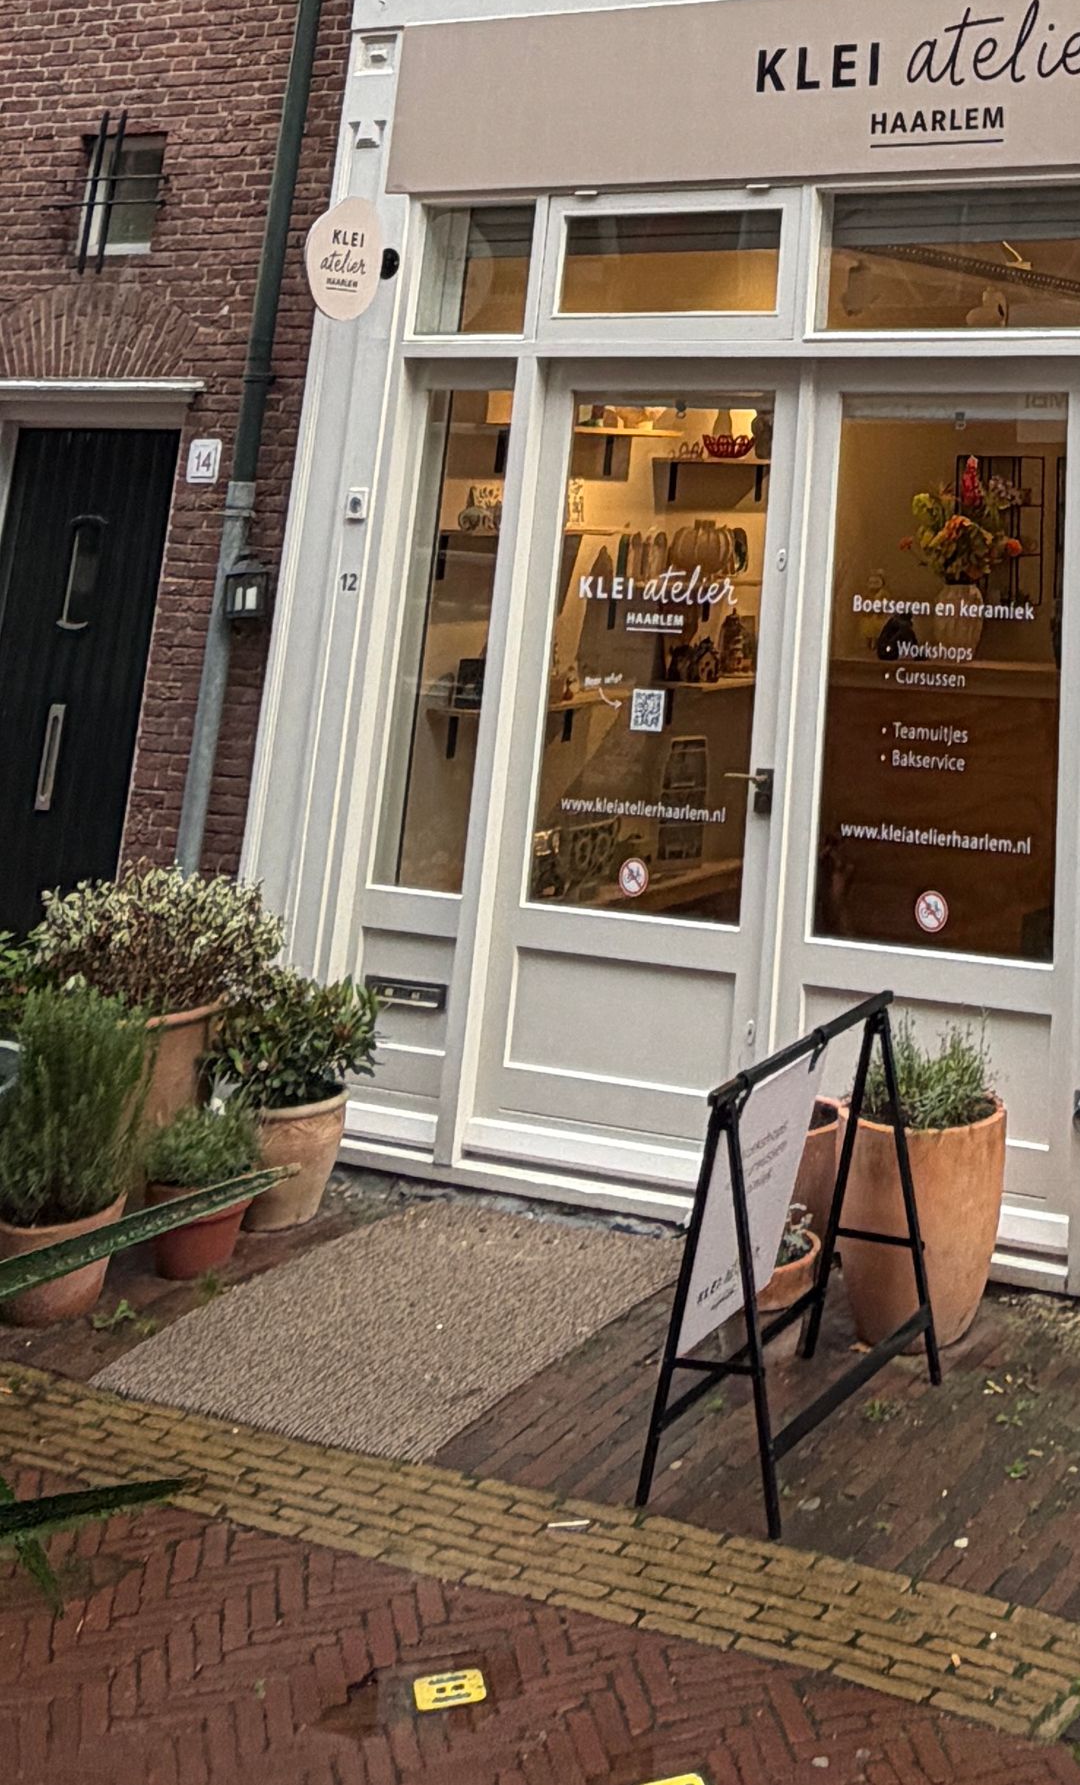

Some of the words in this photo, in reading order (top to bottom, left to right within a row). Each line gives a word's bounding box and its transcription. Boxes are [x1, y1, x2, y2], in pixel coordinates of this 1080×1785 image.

[755, 41, 881, 93] KLEI
[870, 106, 1004, 135] HAARLEM
[332, 228, 365, 248] KLEI
[319, 249, 367, 276] atelier
[194, 450, 212, 472] 14
[340, 572, 358, 592] 12
[578, 575, 634, 600] KLEI
[643, 564, 738, 606] atelier
[626, 612, 684, 628] HAARLEM
[852, 595, 930, 616] Boetseren
[935, 600, 955, 617] en
[959, 599, 1035, 621] keramiek
[896, 640, 973, 662] Workshops
[895, 667, 966, 688] Cursussen
[892, 721, 968, 746] Teamuitjes
[891, 749, 965, 772] Bakservice
[561, 796, 726, 824] www.kleiatelierhaarlem.nl
[840, 822, 1032, 855] www.kleiatelierhaarlem.nl
